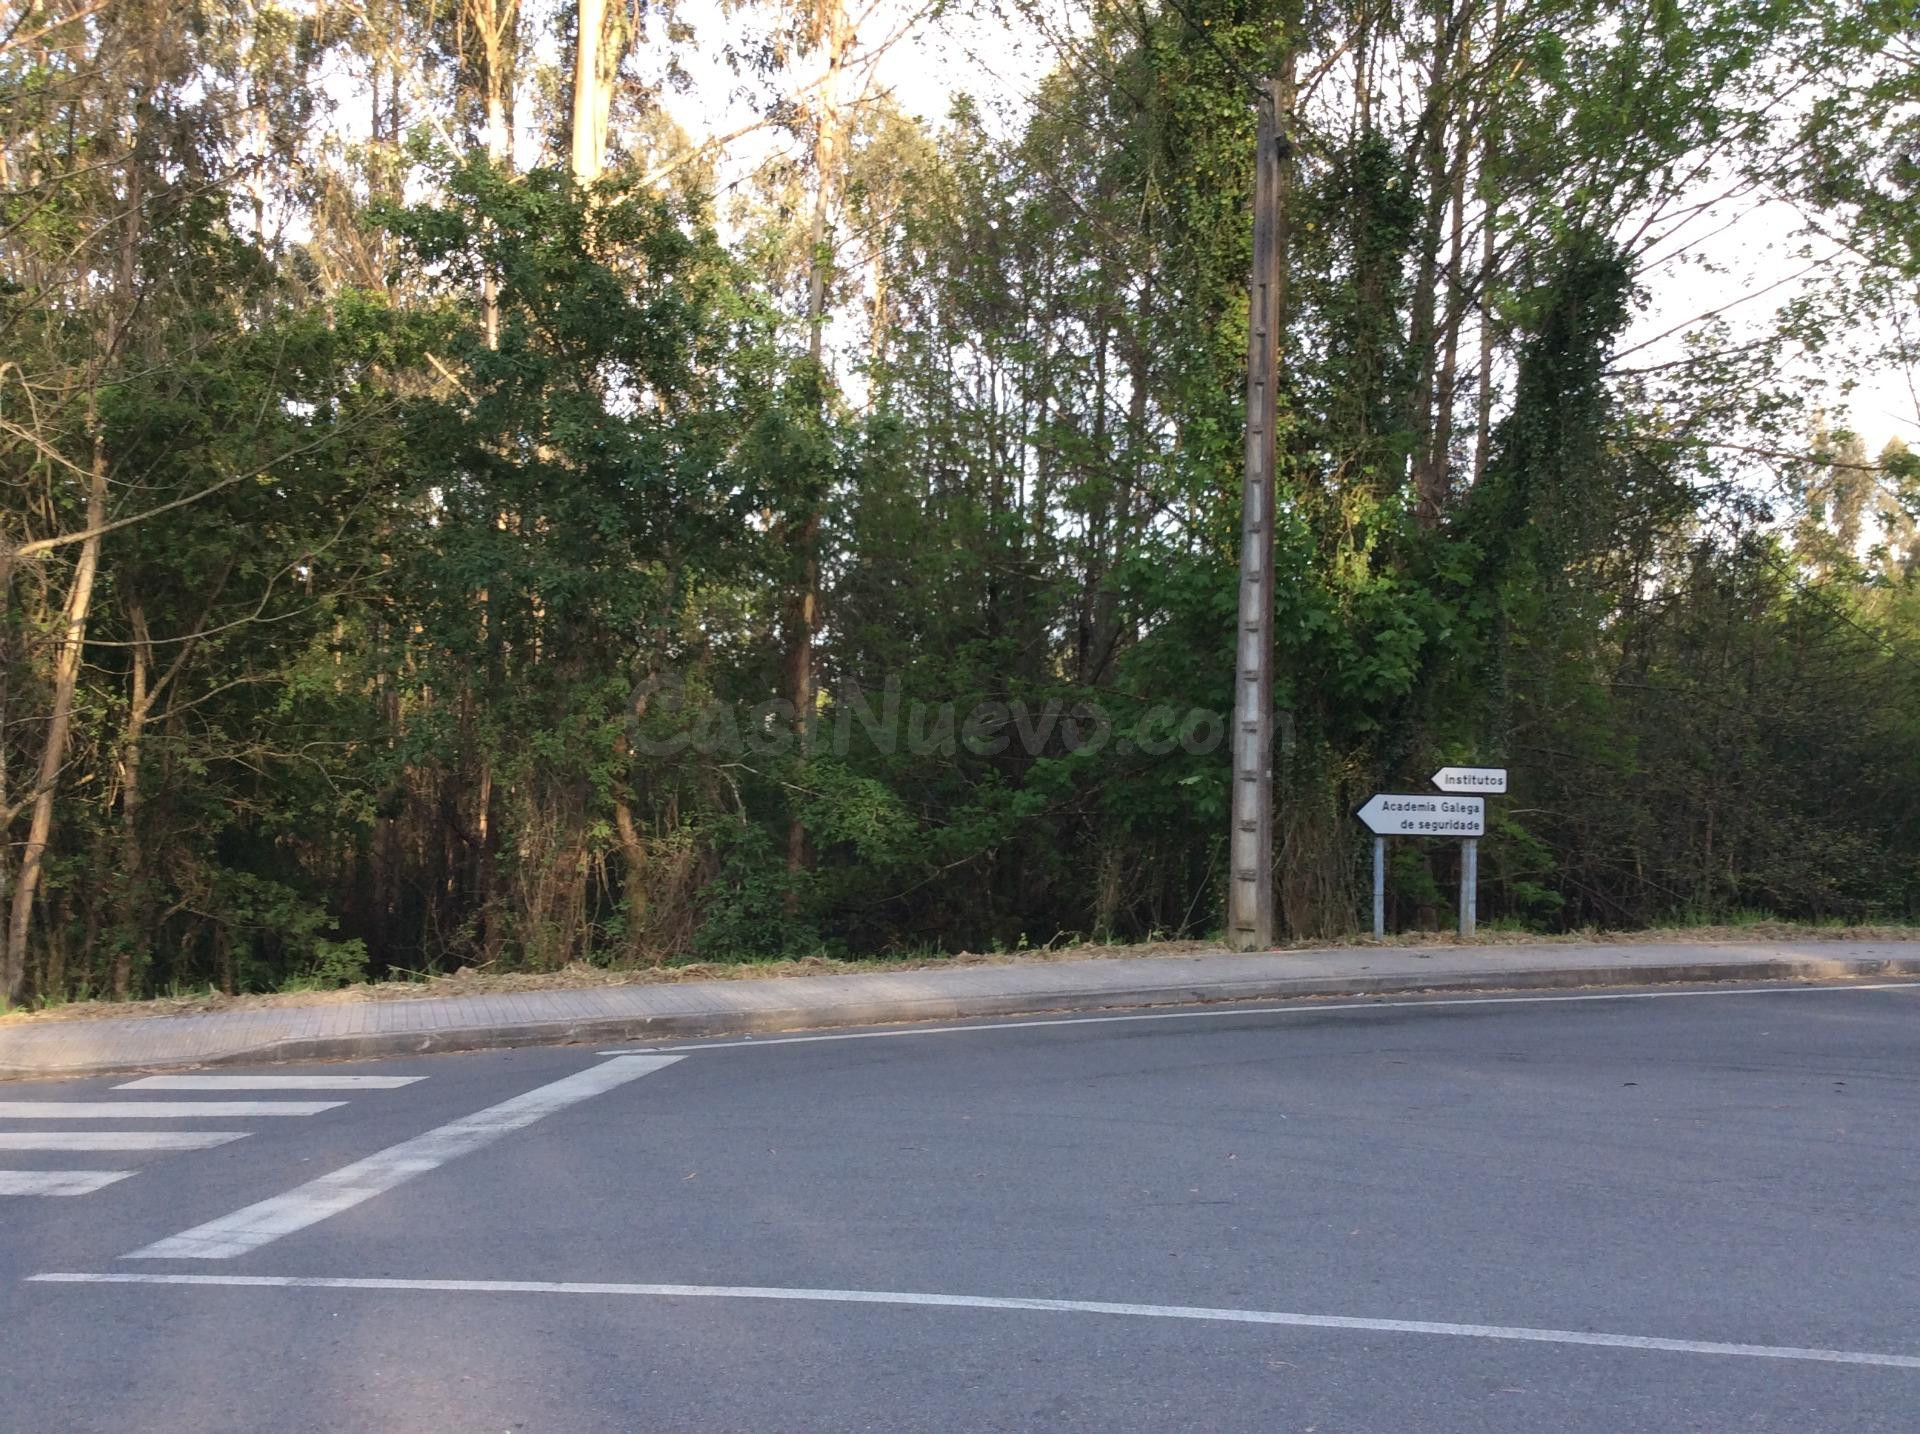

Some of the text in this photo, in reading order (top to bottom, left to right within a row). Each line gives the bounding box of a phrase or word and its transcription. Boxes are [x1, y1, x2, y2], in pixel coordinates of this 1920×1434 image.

[1382, 801, 1480, 815] Academia Galega
[1400, 819, 1480, 832] de seguridade
